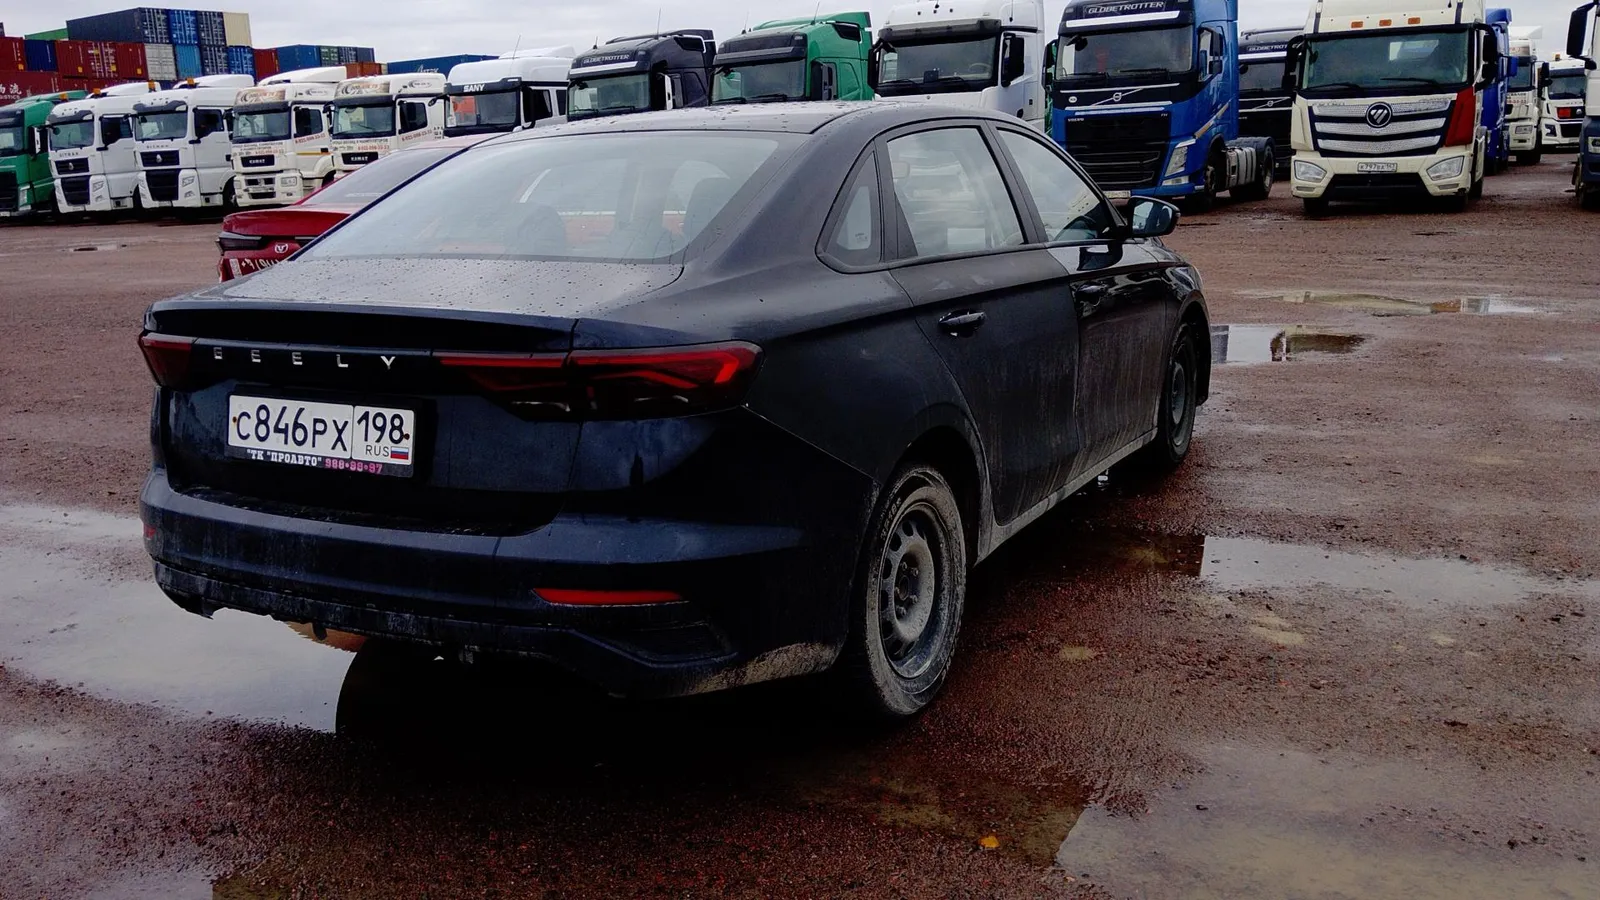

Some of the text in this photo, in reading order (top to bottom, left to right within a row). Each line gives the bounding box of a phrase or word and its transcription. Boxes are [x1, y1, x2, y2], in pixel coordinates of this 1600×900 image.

[1088, 2, 1164, 14] GLOBETROTTER
[463, 84, 485, 92] SANY
[213, 346, 396, 370] GEELY
[236, 404, 404, 452] С846РХ 198
[365, 444, 390, 457] RUS
